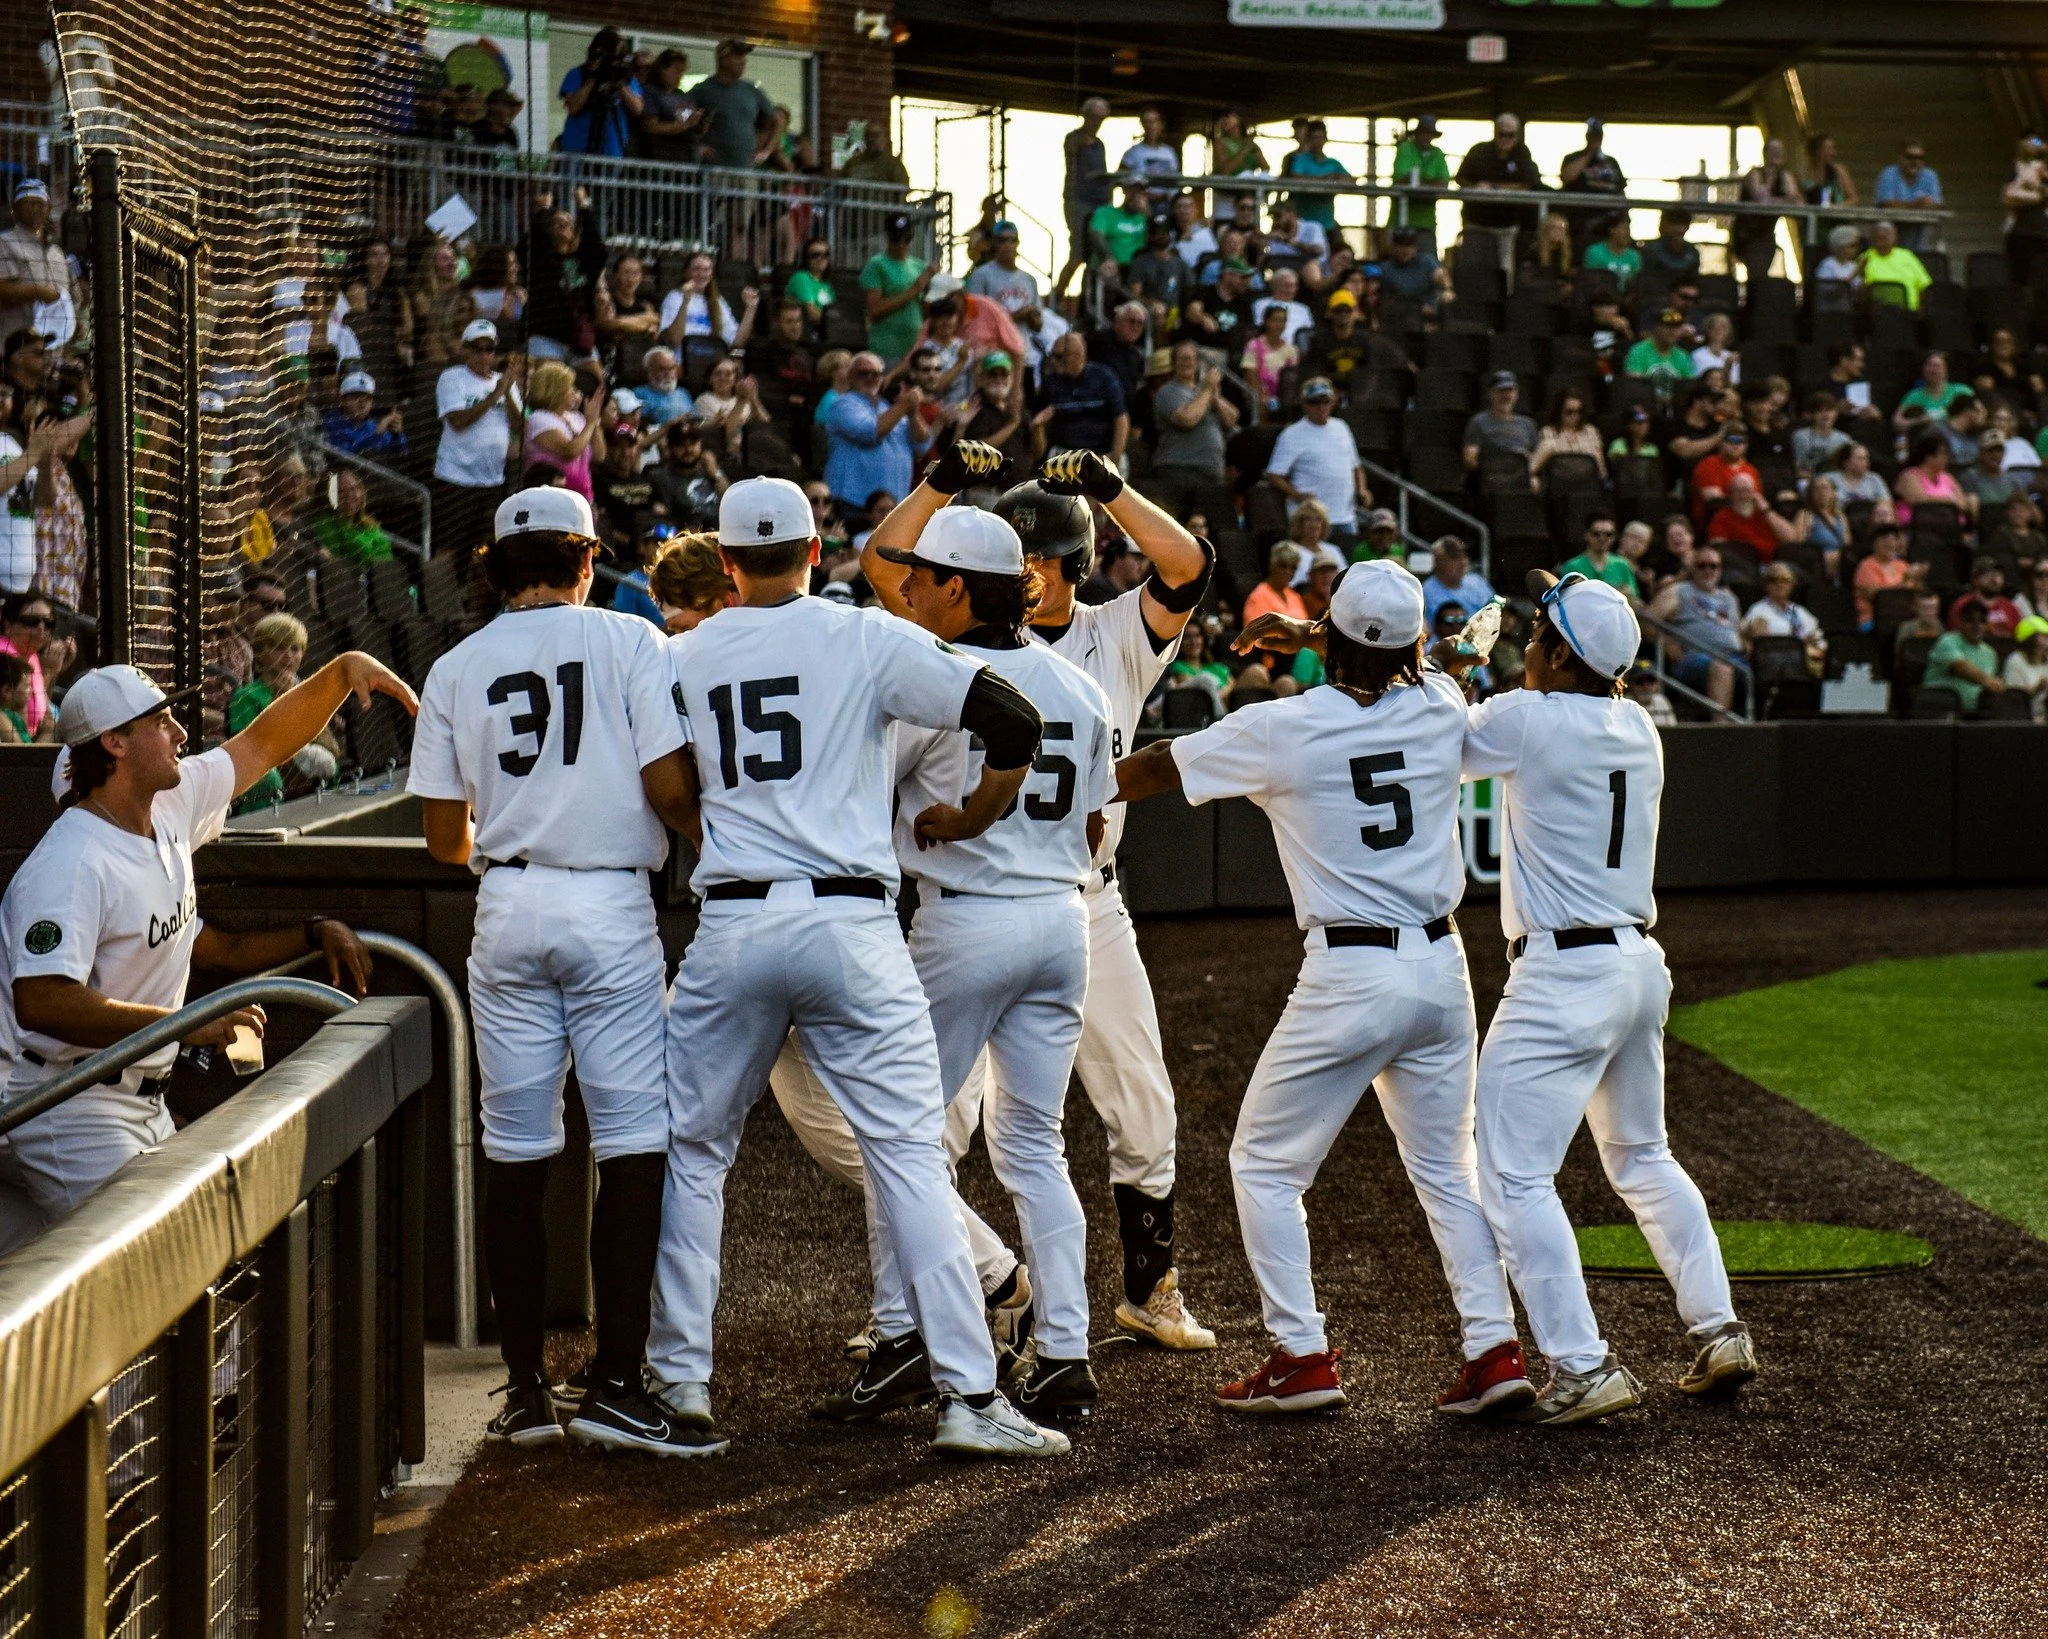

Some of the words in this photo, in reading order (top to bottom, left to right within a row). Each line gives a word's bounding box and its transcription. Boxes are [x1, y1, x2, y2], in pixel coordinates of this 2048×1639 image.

[486, 661, 584, 778] 31
[707, 675, 803, 790] 15
[1111, 727, 1124, 759] 8
[1348, 750, 1414, 852] 5
[1606, 769, 1627, 869] 1
[148, 900, 183, 949] Coal
